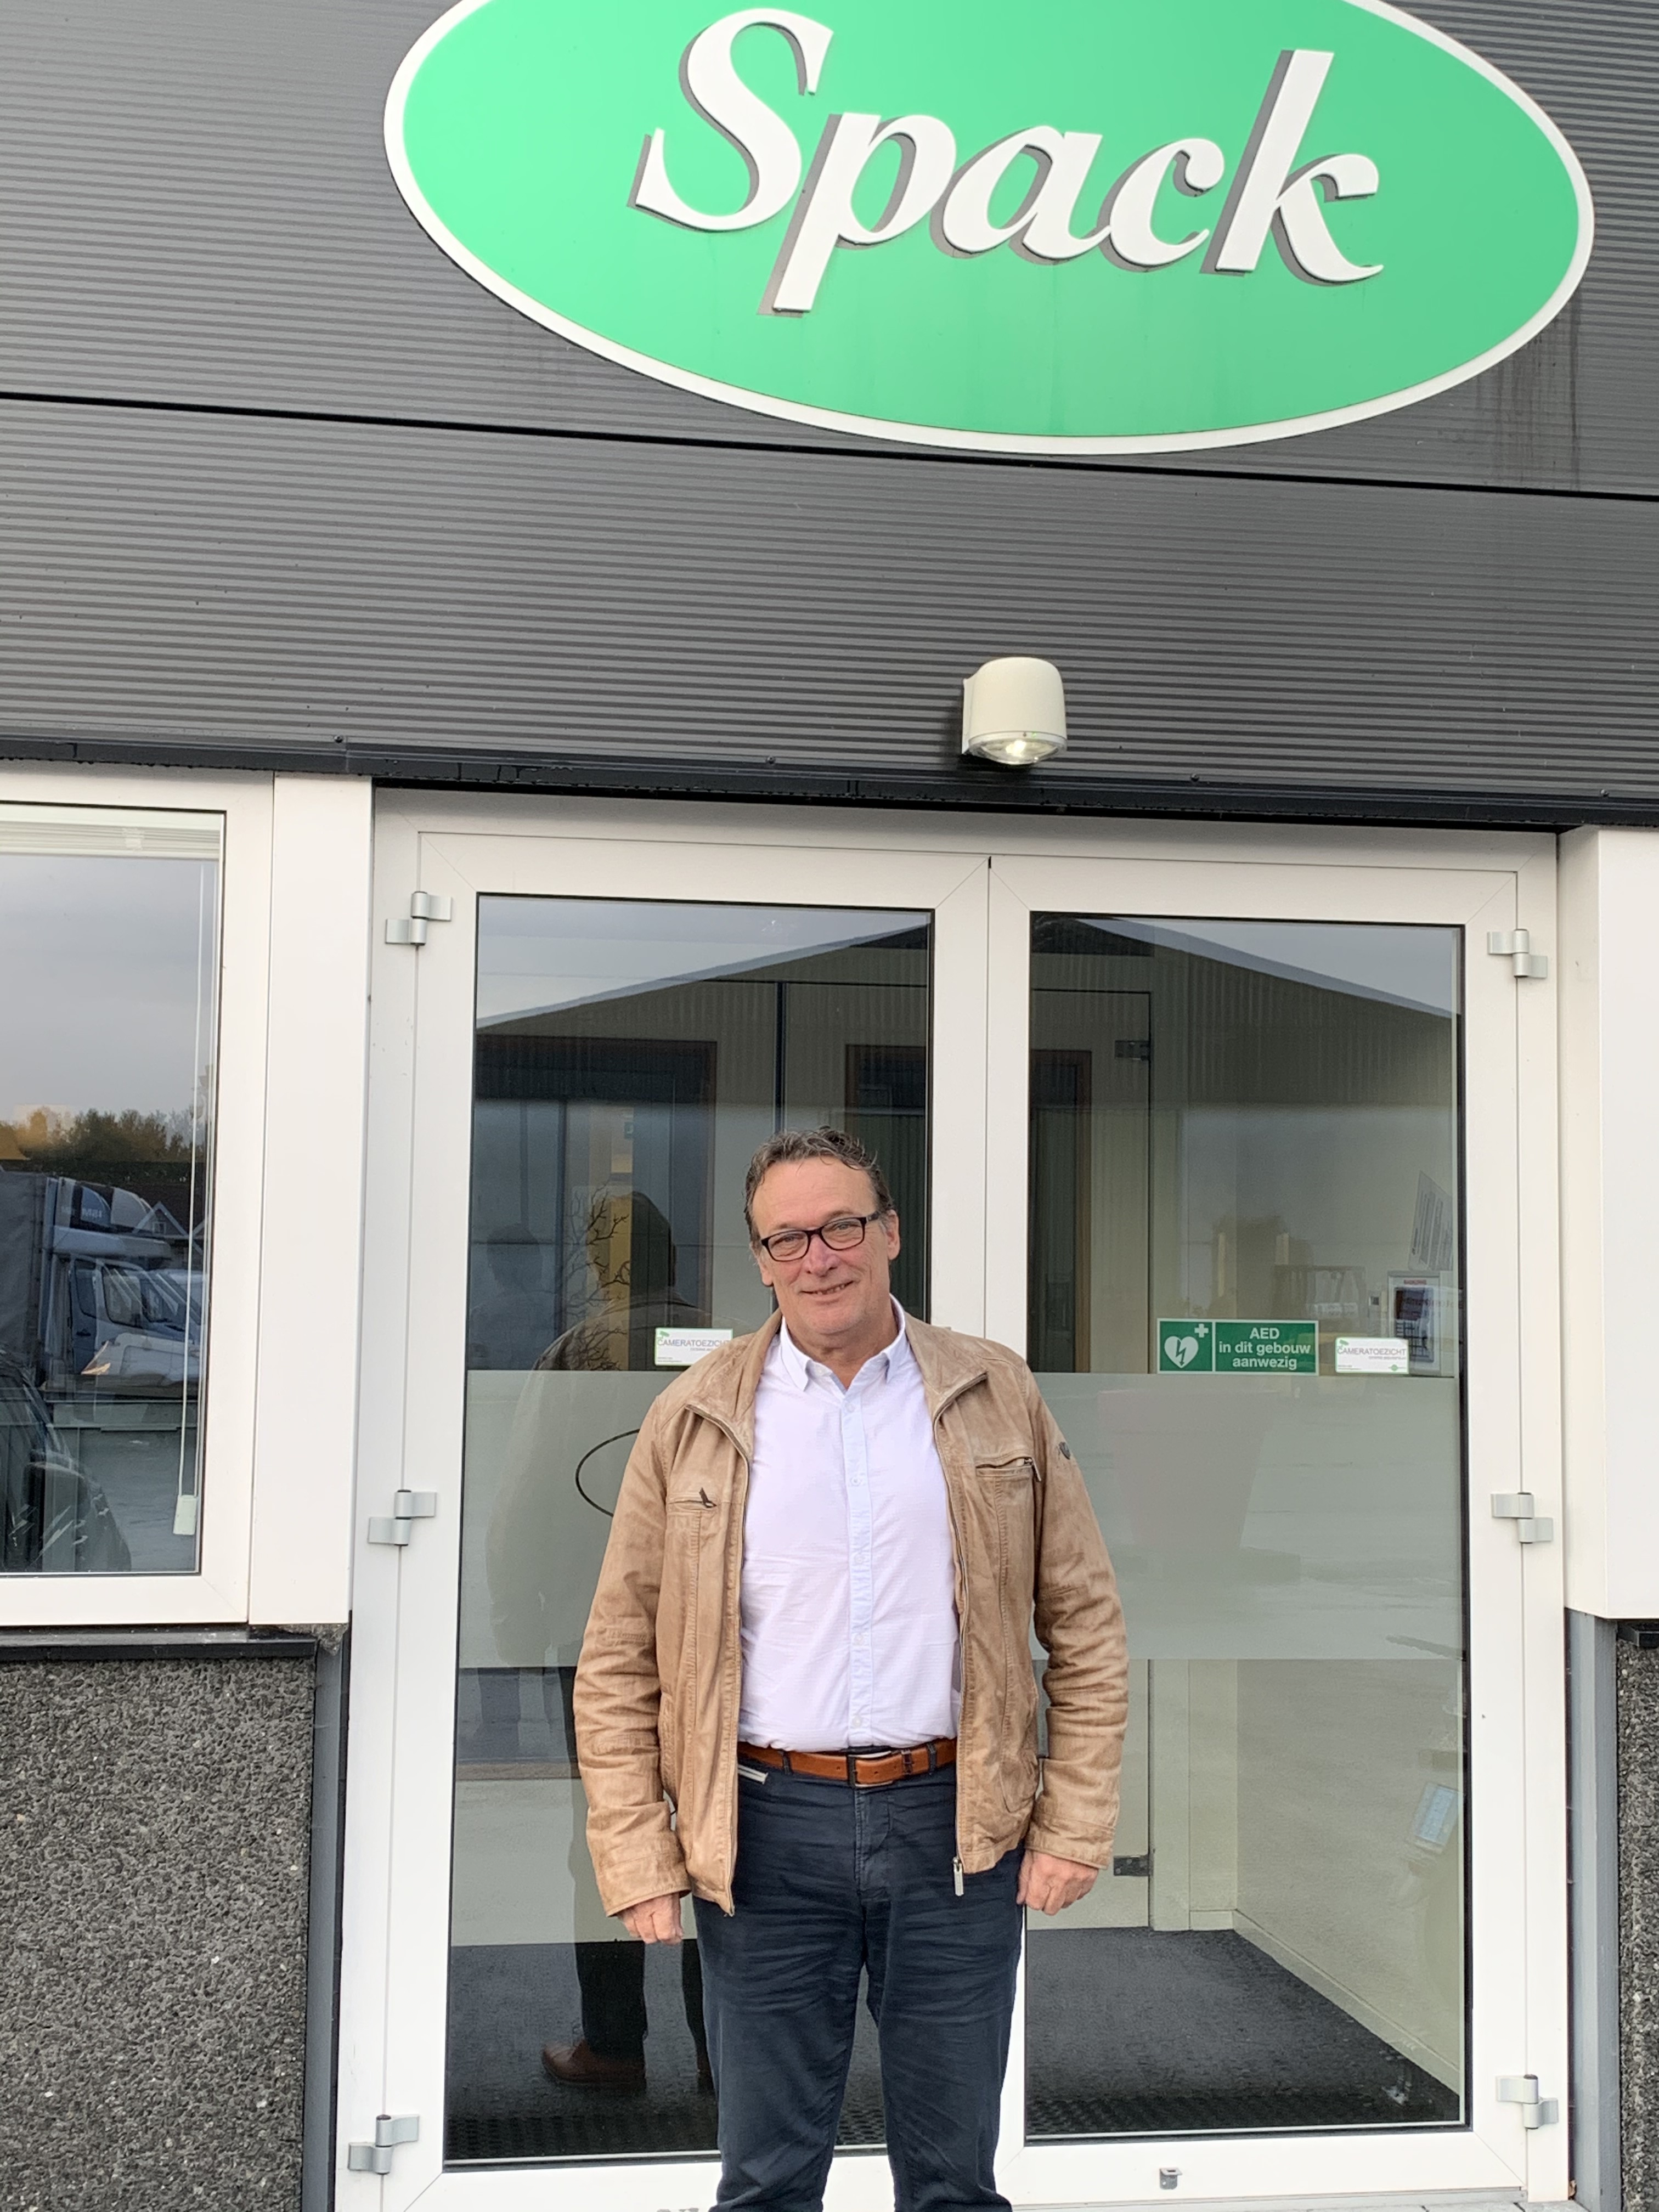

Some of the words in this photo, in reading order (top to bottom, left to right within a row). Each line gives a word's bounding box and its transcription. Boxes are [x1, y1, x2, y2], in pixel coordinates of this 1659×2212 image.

[634, 8, 1384, 314] Spack
[1249, 1327, 1280, 1340] AED
[1218, 1341, 1231, 1353] in
[1234, 1341, 1254, 1354] dit
[1256, 1342, 1311, 1356] gebouw
[1337, 1347, 1407, 1356] CAMERATOEZICHT
[1232, 1356, 1297, 1370] aanwezig
